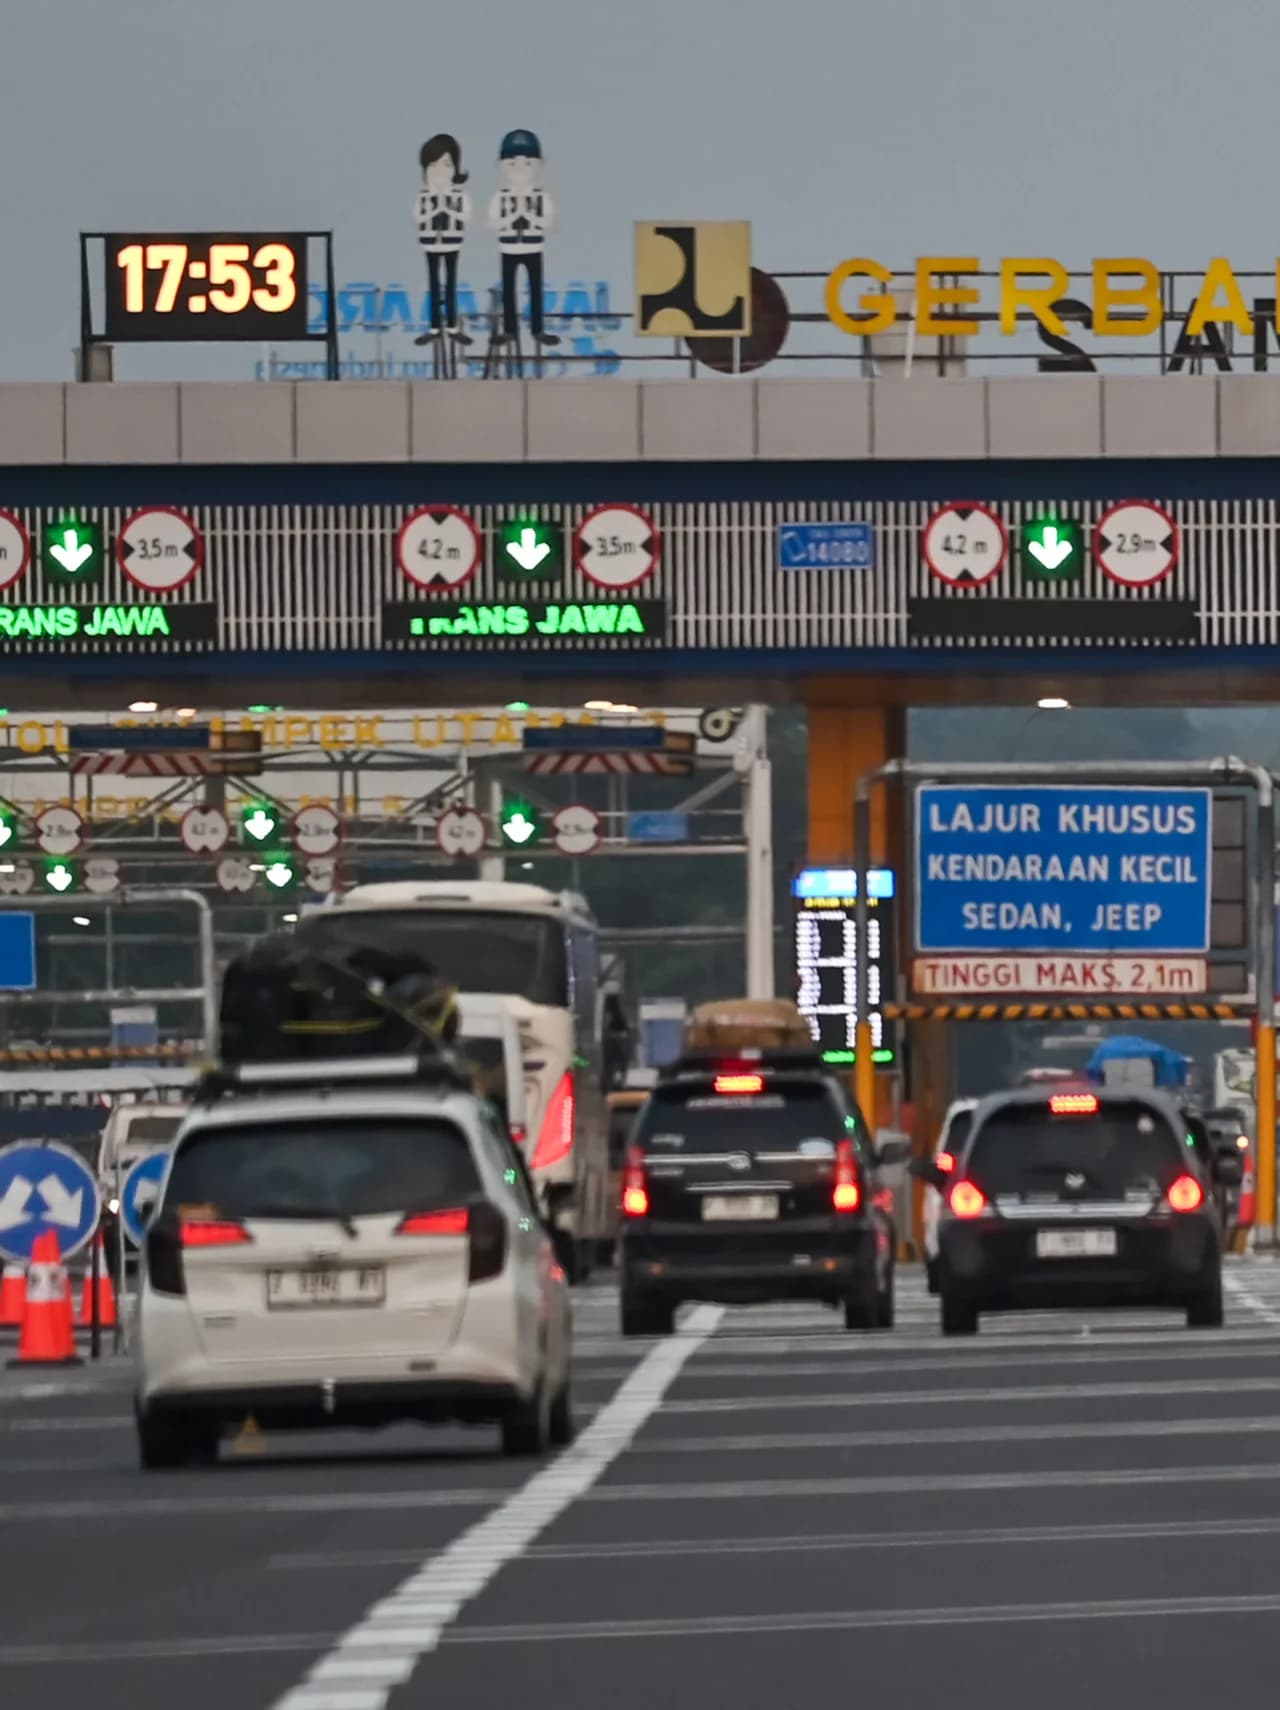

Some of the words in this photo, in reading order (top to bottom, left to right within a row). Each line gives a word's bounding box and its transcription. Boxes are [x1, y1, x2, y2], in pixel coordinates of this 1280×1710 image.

[115, 242, 299, 313] 17:53
[84, 606, 170, 635] JAWA
[536, 604, 645, 635] JAWA
[931, 804, 1040, 832] LAJUR
[1059, 804, 1195, 834] KHUSUS
[929, 854, 1108, 881] KENDARAAN
[1121, 855, 1197, 883] KECIL
[1091, 903, 1162, 930] JEEP
[926, 963, 1021, 990] TINGGI
